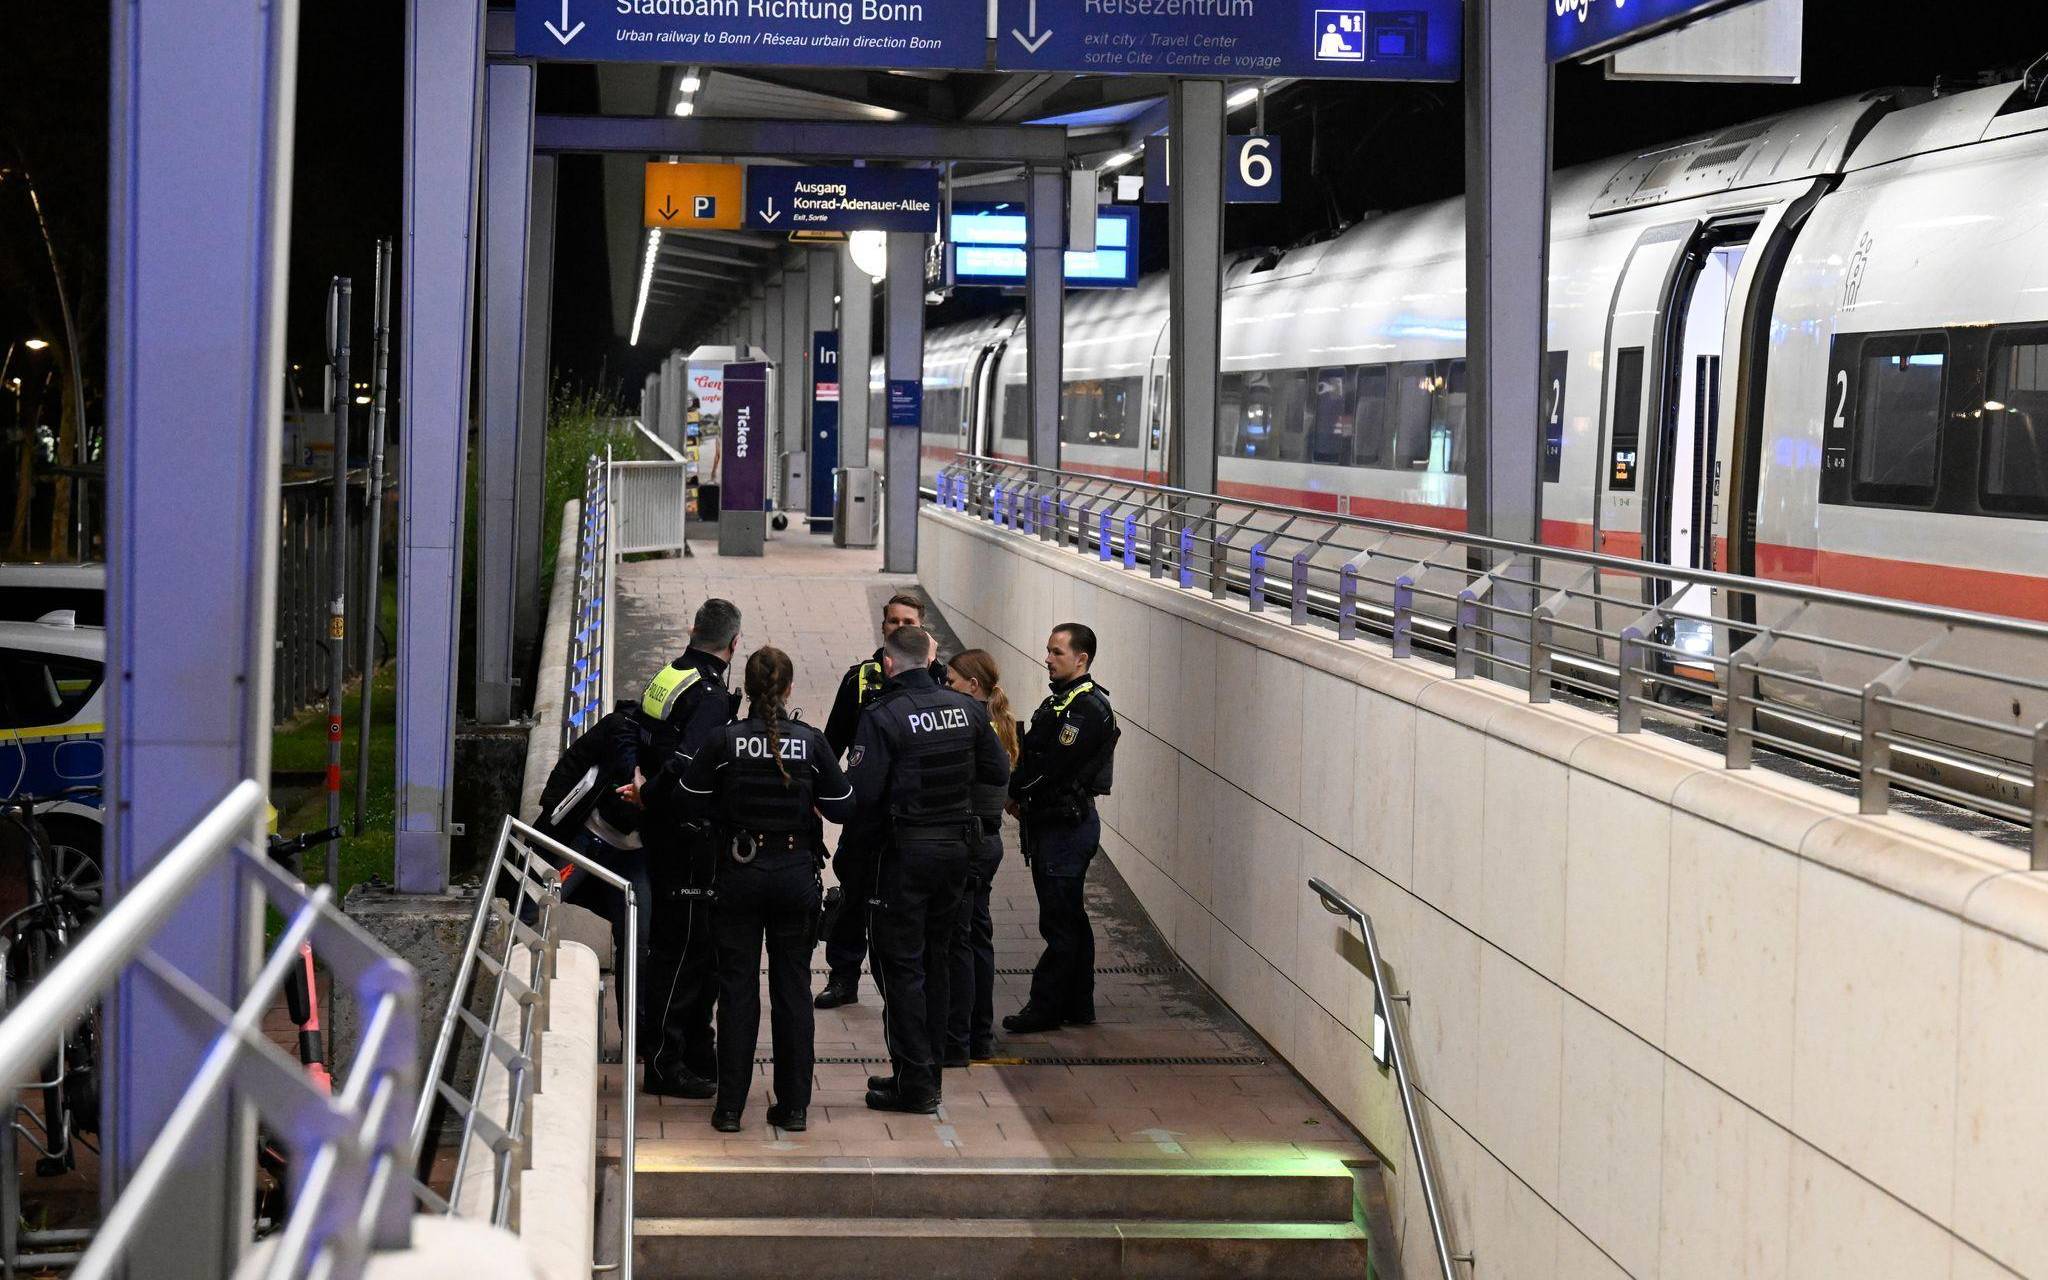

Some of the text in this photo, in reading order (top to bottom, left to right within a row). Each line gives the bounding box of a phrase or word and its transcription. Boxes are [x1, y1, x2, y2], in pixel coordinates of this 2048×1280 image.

[616, 0, 923, 25] Stadtbahn Richtung Bonn
[1084, 0, 1253, 17] Reisezentrum
[616, 29, 942, 49] Urban railway to Bonn / Réseau urbain direction Bonn
[1084, 33, 1109, 46] exit
[1112, 33, 1136, 48] city
[1150, 33, 1189, 47] Travel
[1193, 33, 1239, 48] Center
[1084, 51, 1123, 64] sortie
[1166, 51, 1210, 66] Centre
[1214, 53, 1231, 66] de
[1235, 55, 1282, 69] voyage
[1240, 138, 1272, 187] 6
[794, 181, 847, 196] Ausgang
[695, 197, 709, 218] P
[793, 197, 930, 212] Konrad-Adenauer-Allee
[808, 213, 828, 222] Sortie
[1550, 379, 1560, 424] 2
[1833, 369, 1848, 428] 2
[737, 406, 751, 458] Tickets
[908, 708, 969, 734] POLIZEI
[735, 736, 807, 760] POLZEI
